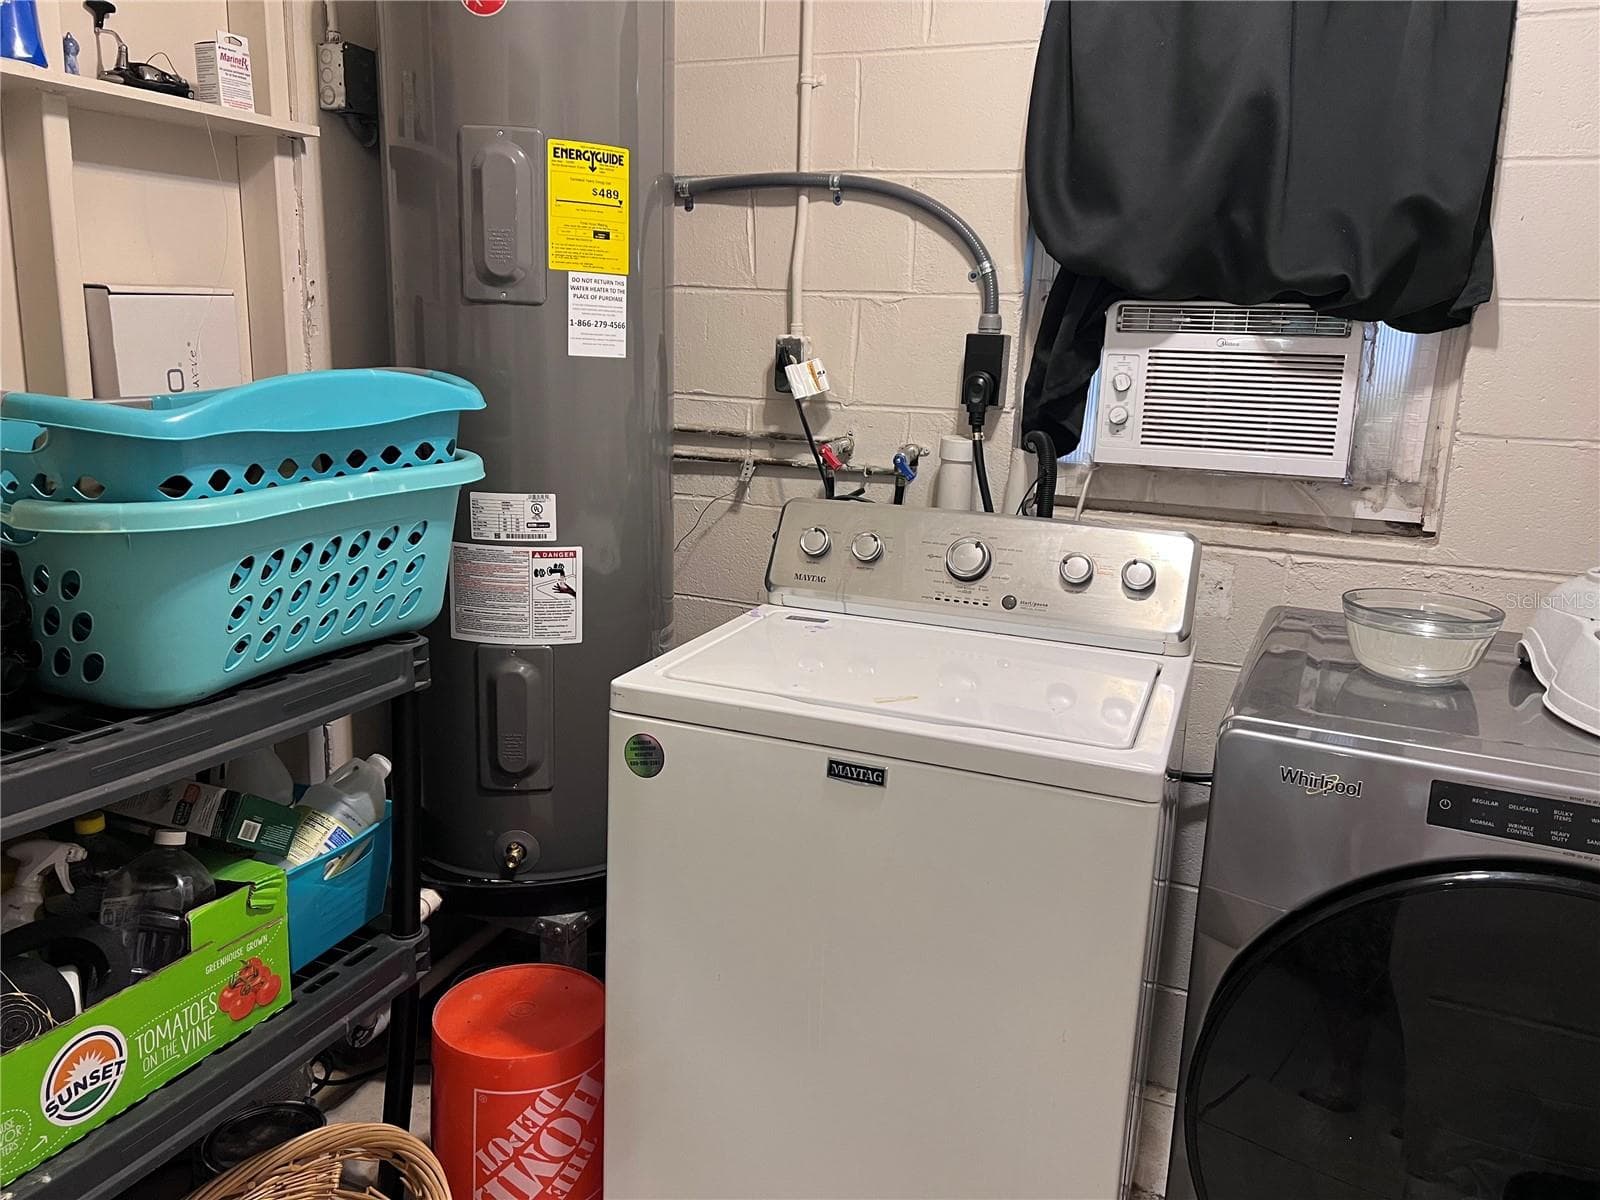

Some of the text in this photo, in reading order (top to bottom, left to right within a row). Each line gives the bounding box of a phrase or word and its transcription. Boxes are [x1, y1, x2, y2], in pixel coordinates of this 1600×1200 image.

[592, 188, 619, 200] $489
[570, 319, 626, 330] 1-866-279-4566
[794, 572, 827, 584] MAYTAG
[831, 763, 882, 783] MAYTAG
[1280, 765, 1363, 798] Whirlpool
[1472, 797, 1499, 807] REGULAR
[1508, 803, 1539, 814] DELICATES
[1553, 809, 1574, 817] BULKY
[1470, 818, 1495, 828] NORMAL
[1553, 815, 1572, 823] ITEMS
[1508, 822, 1535, 832] WRINKLE
[1506, 828, 1534, 838] CONTROL
[1550, 830, 1570, 838] HEAVY
[1551, 835, 1568, 843] DUTY
[205, 934, 268, 975] GREENHOUSE GROWN
[134, 991, 218, 1060] TOMATOES
[143, 1015, 217, 1073] ON THE VINE
[45, 1059, 126, 1118] SUNSET
[475, 1088, 563, 1176] DEPOT
